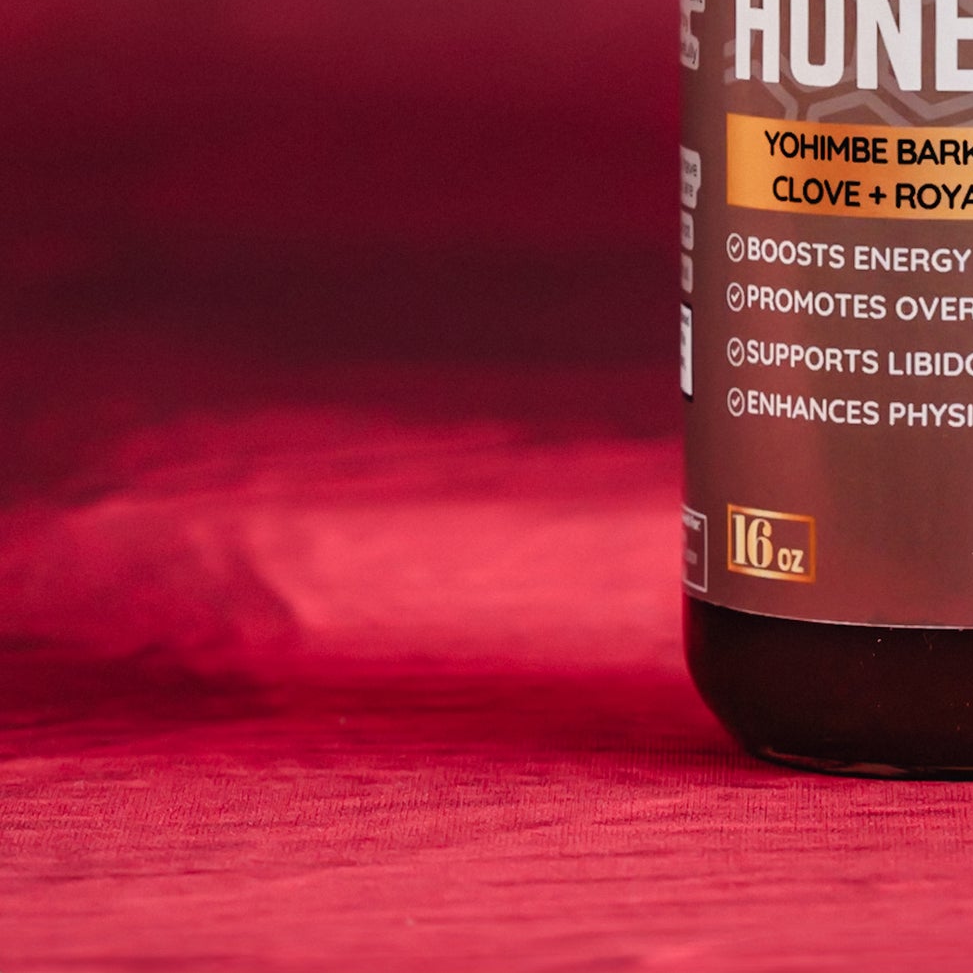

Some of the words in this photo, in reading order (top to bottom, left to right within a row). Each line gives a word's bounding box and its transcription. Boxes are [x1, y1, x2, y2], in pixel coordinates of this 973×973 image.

[764, 130, 889, 165] YOHIMBE
[772, 175, 861, 208] CLOVE
[747, 236, 845, 269] BOOSTS
[854, 245, 972, 273] ENERGY
[747, 284, 887, 320] PROMOTES
[746, 339, 879, 374] SUPPORTS
[747, 390, 880, 425] ENHANCES
[732, 513, 774, 568] 16
